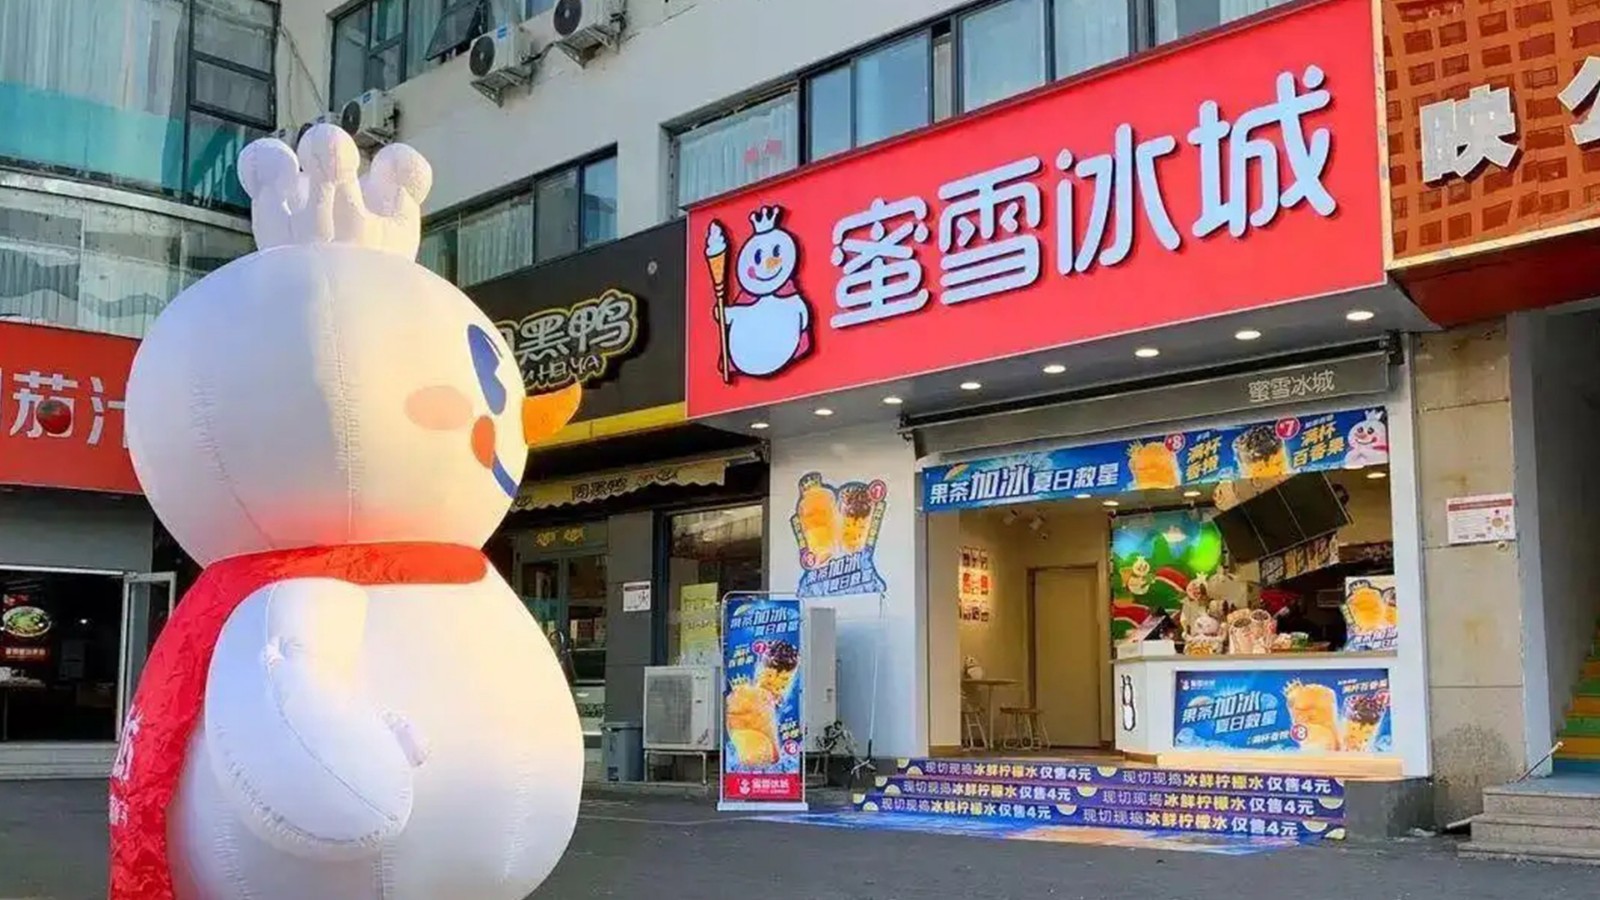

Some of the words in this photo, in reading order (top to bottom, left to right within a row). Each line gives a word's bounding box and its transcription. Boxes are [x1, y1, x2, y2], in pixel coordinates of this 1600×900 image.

[830, 65, 1338, 330] 蜜雪冰城
[1248, 369, 1335, 403] 蜜雪冰城
[0, 370, 129, 449] 茄汁
[930, 463, 1120, 505] 果茶加冰夏日救星
[1040, 767, 1092, 781] 仅售4元
[1020, 786, 1071, 802] 仅售4元
[1267, 777, 1331, 794] 仅售4元
[999, 805, 1051, 820] 仅售4元
[1250, 798, 1315, 815] 仅售4元
[1231, 817, 1298, 837] 仅售4元
